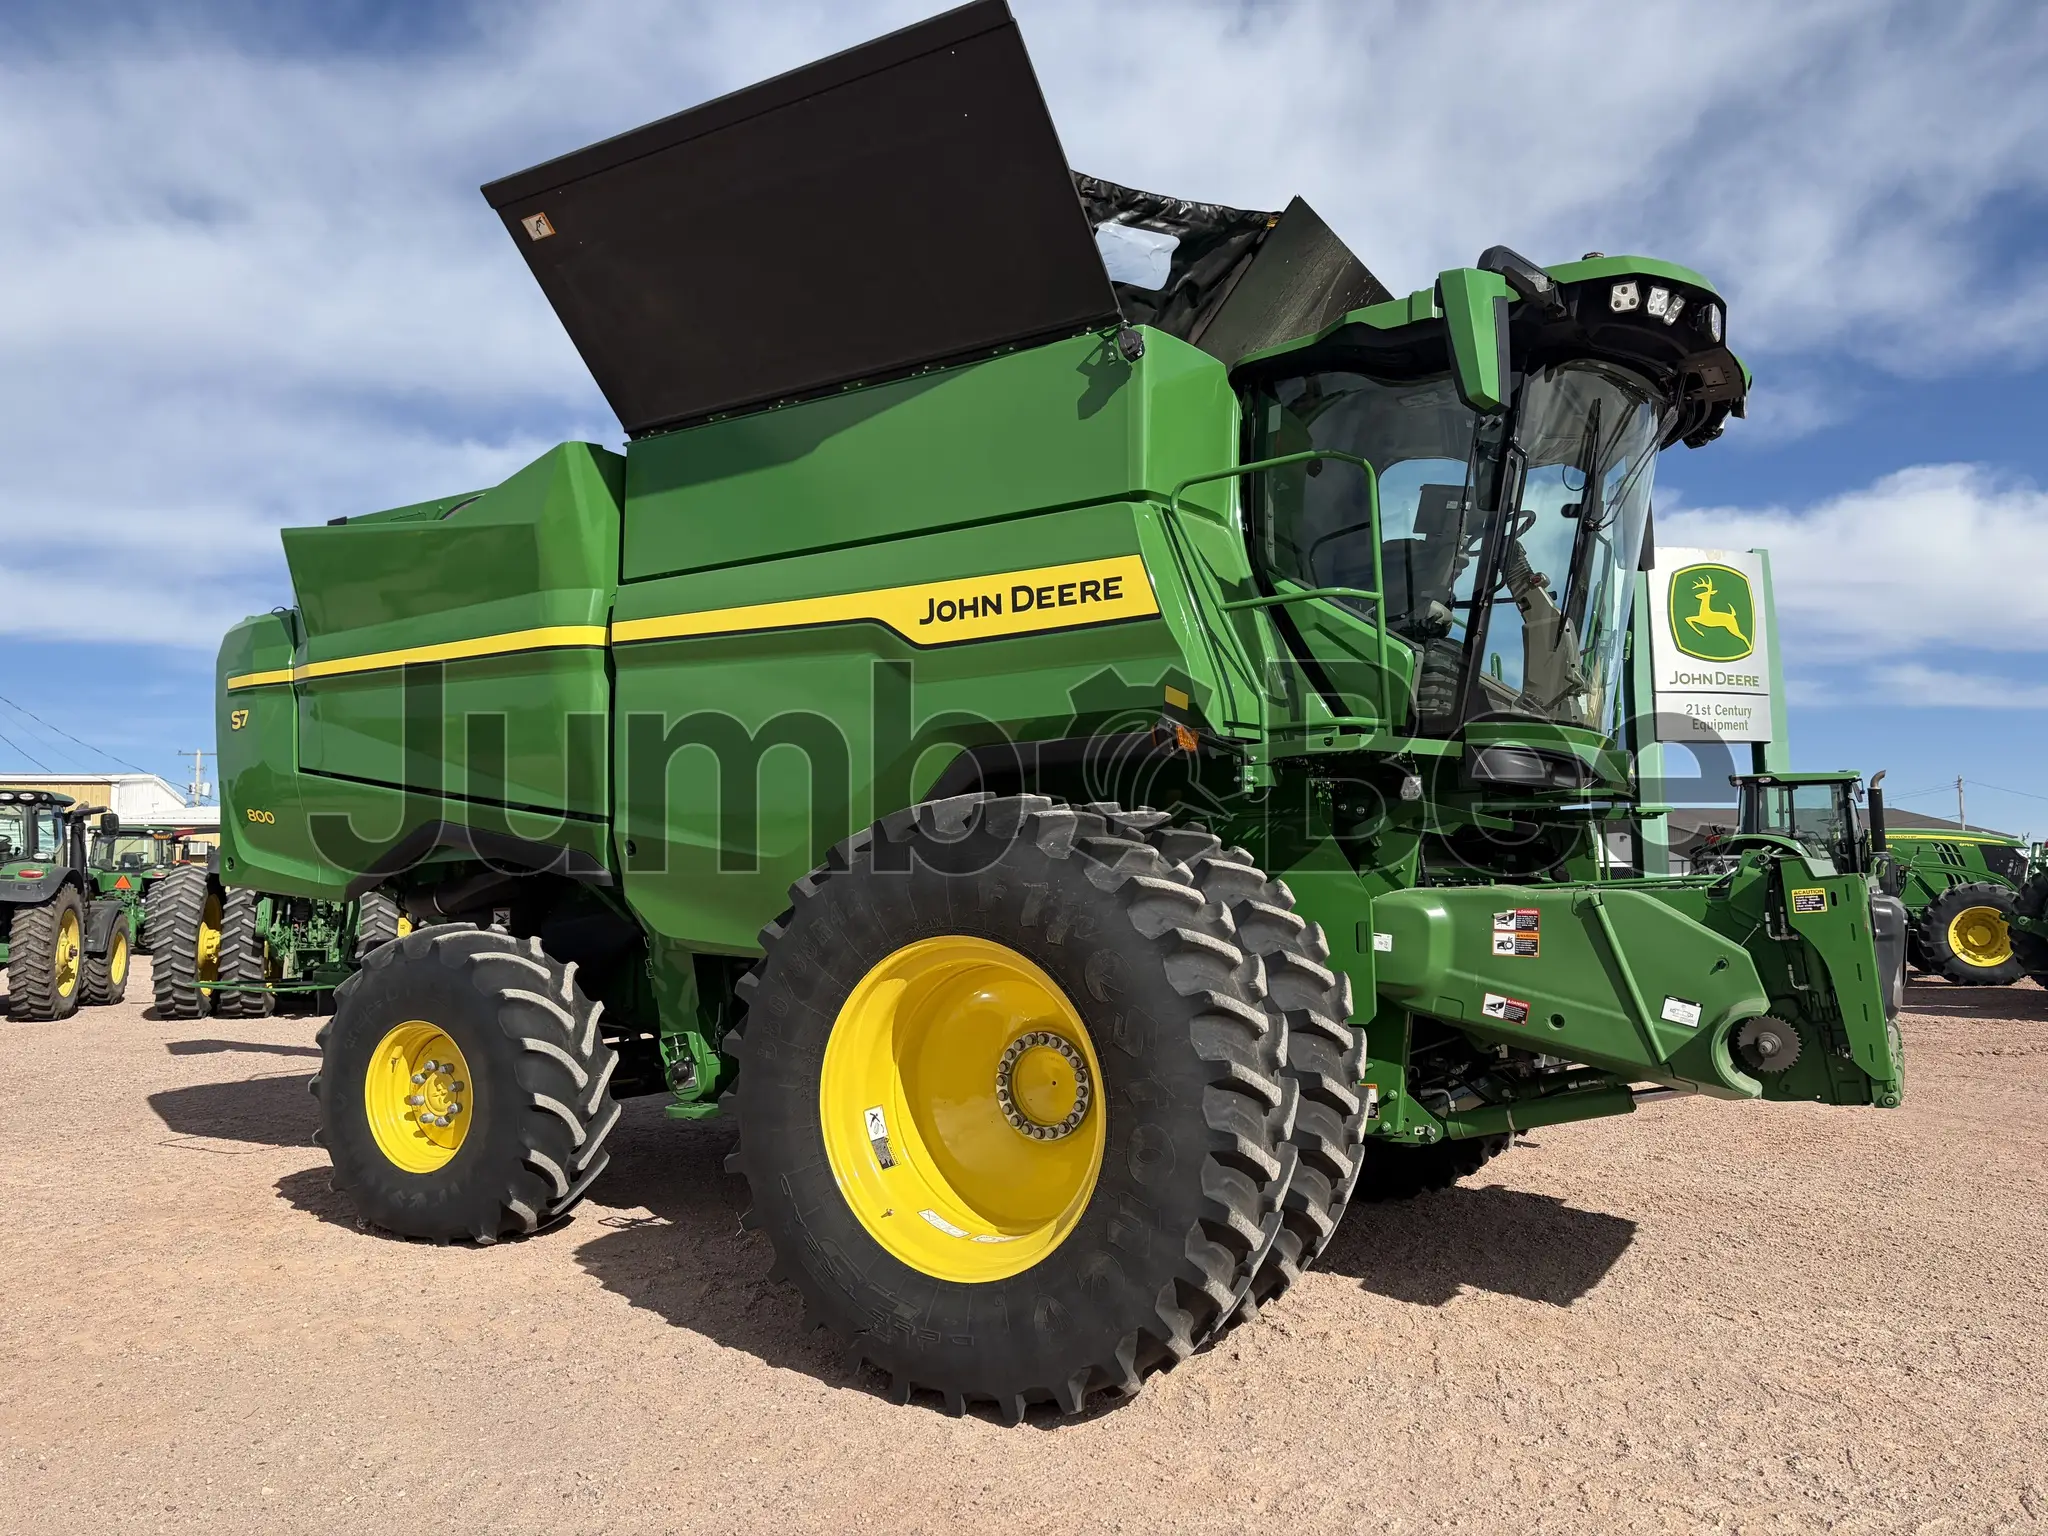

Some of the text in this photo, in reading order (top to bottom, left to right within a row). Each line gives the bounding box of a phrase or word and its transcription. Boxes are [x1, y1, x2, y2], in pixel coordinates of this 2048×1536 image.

[919, 576, 1123, 625] JOHN DEERE
[1669, 670, 1759, 687] JOHN DEERE
[231, 709, 249, 730] S7
[1685, 704, 1752, 718] 21st Century
[1692, 718, 1748, 732] Equipment
[246, 808, 275, 825] 800
